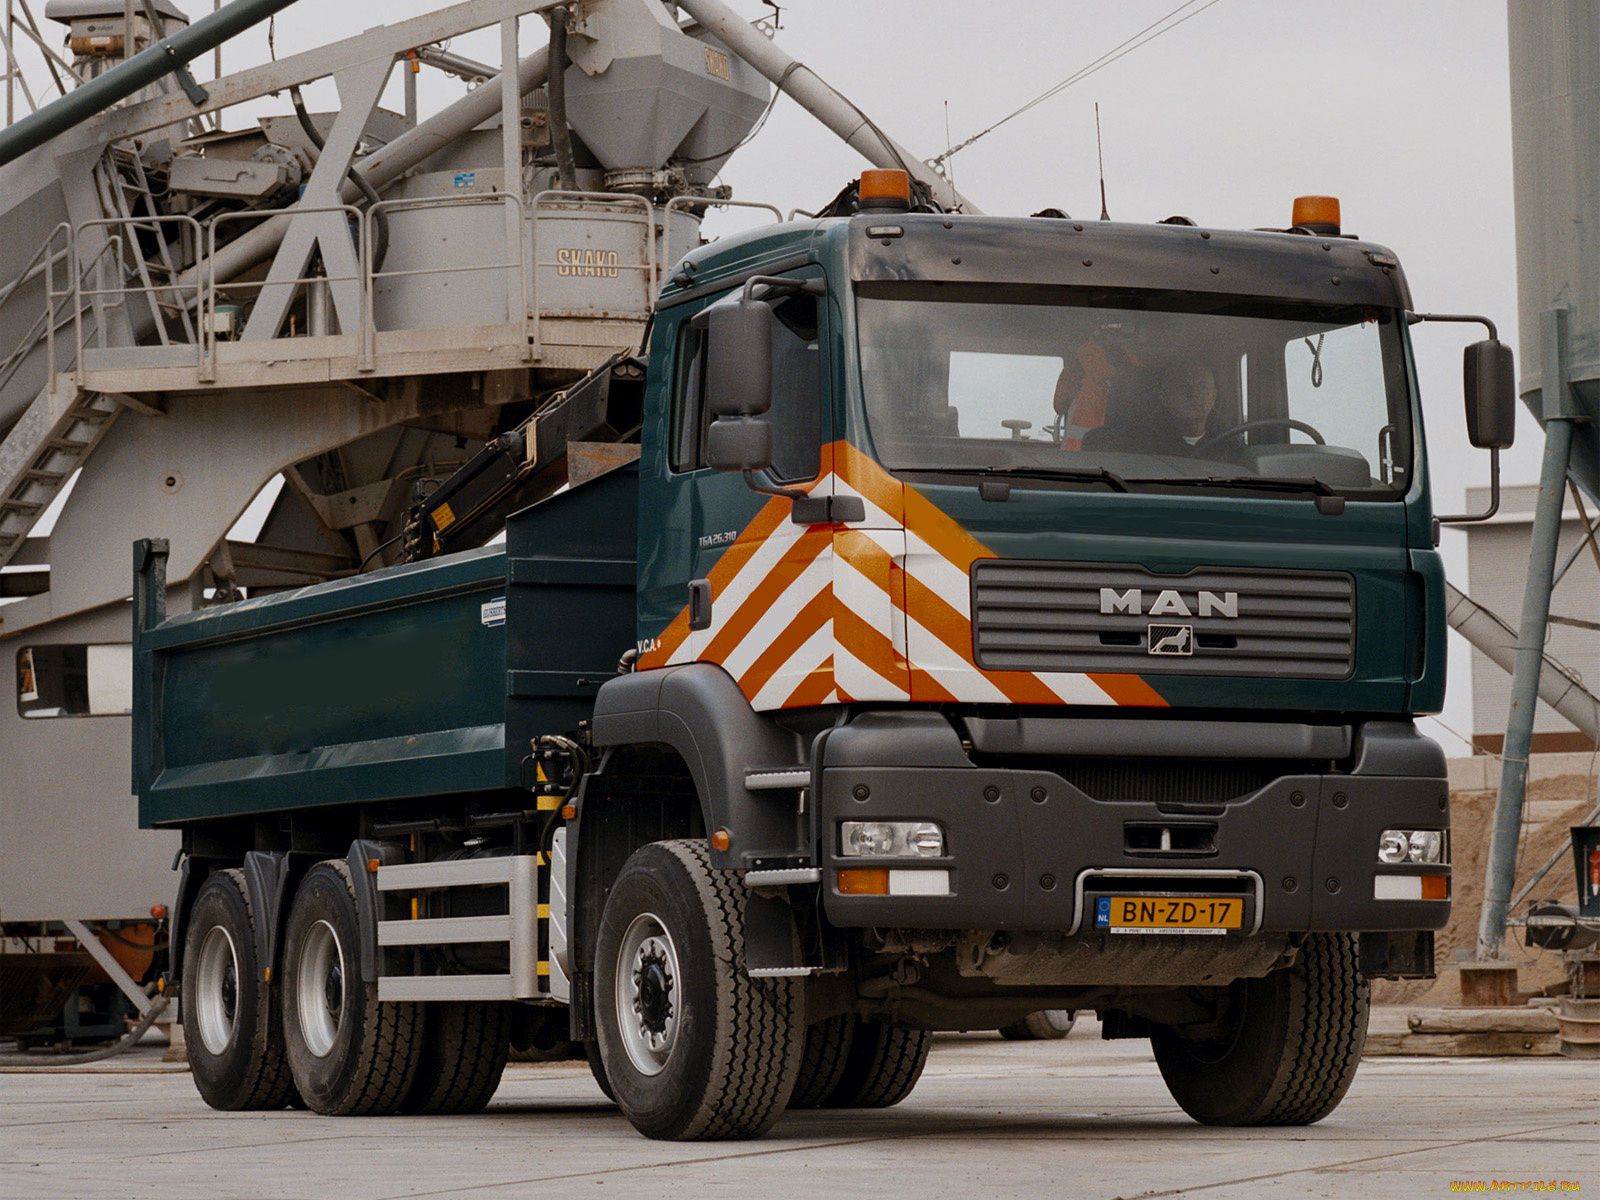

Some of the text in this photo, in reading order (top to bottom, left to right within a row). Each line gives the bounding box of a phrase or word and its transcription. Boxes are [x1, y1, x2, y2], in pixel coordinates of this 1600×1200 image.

[557, 248, 619, 278] SKAKO
[698, 530, 737, 547] TGA 26.310
[1099, 587, 1239, 618] MAN
[1098, 914, 1109, 922] NL
[1122, 901, 1232, 923] BN-ZD-17
